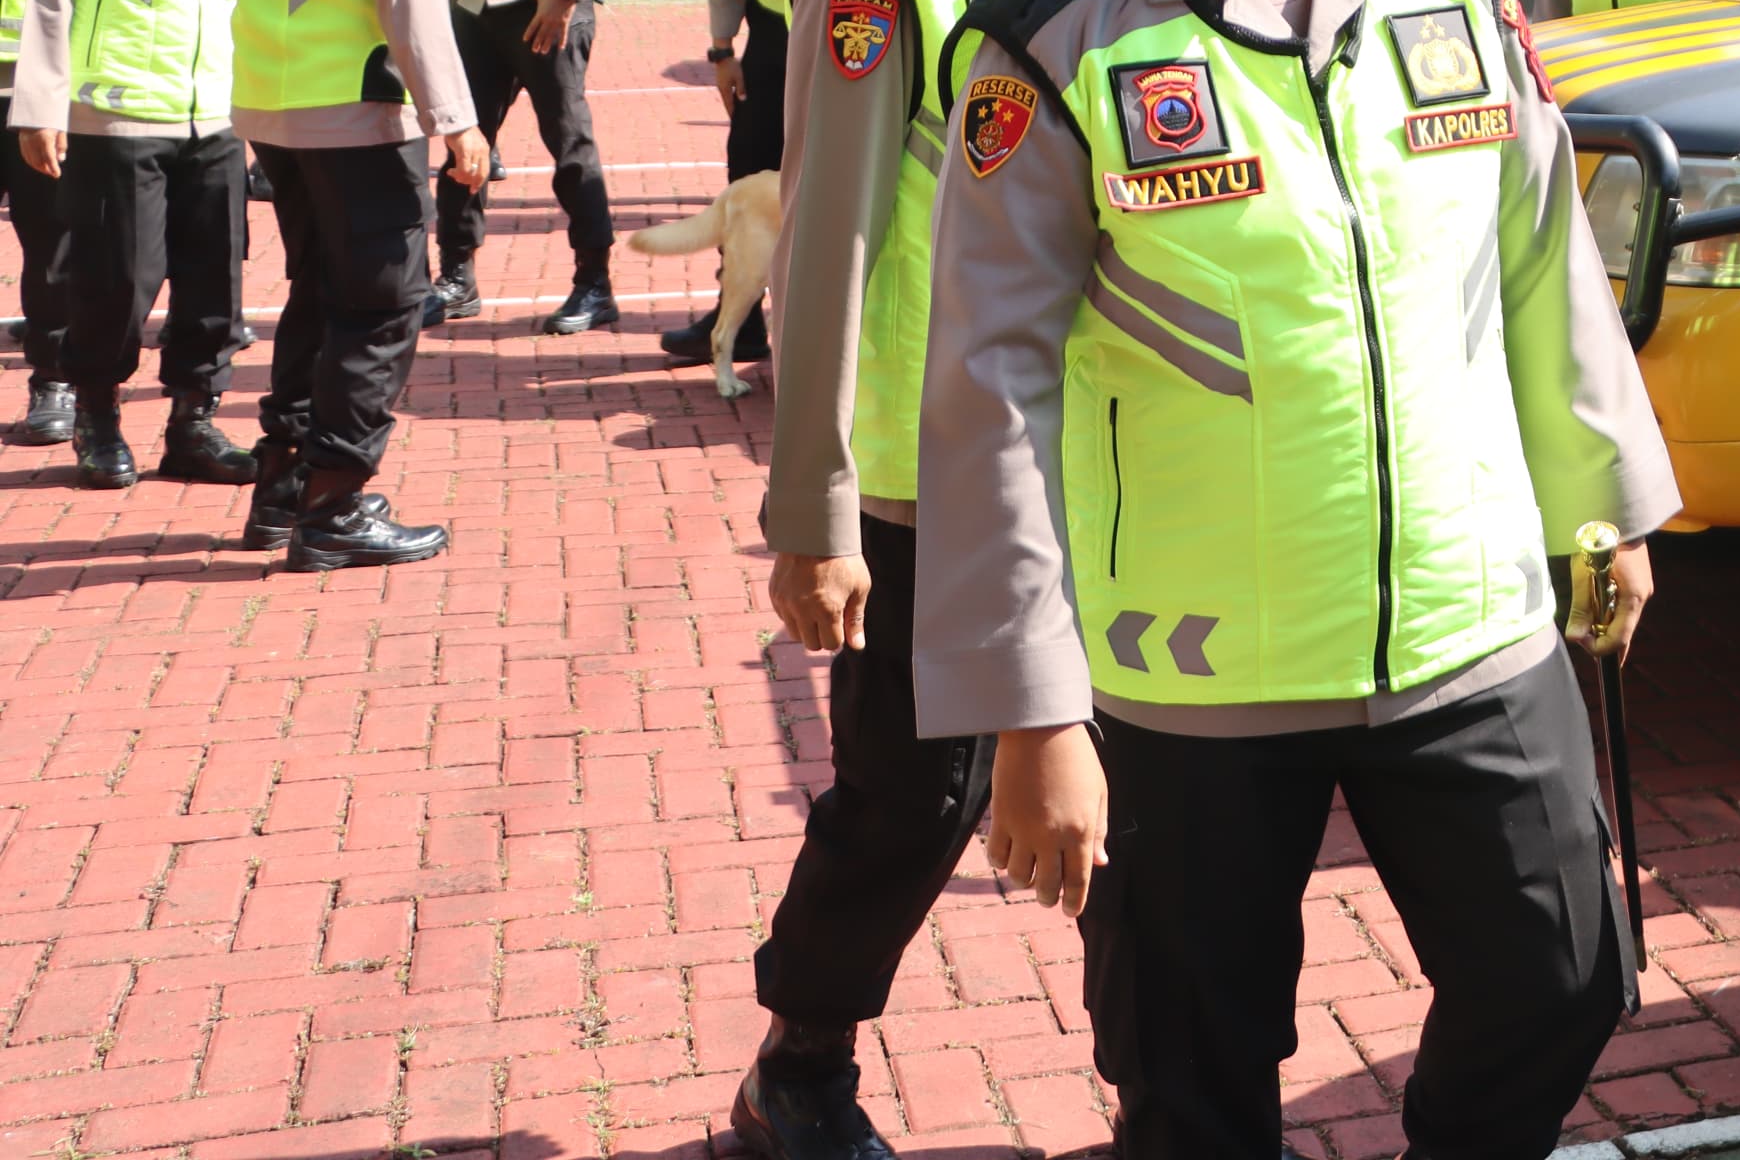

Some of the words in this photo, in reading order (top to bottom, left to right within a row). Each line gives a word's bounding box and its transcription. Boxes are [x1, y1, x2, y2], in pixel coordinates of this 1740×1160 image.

[972, 77, 1034, 106] RESERSE
[1416, 108, 1509, 147] KAPOLRES
[1117, 162, 1250, 205] WAHYU
